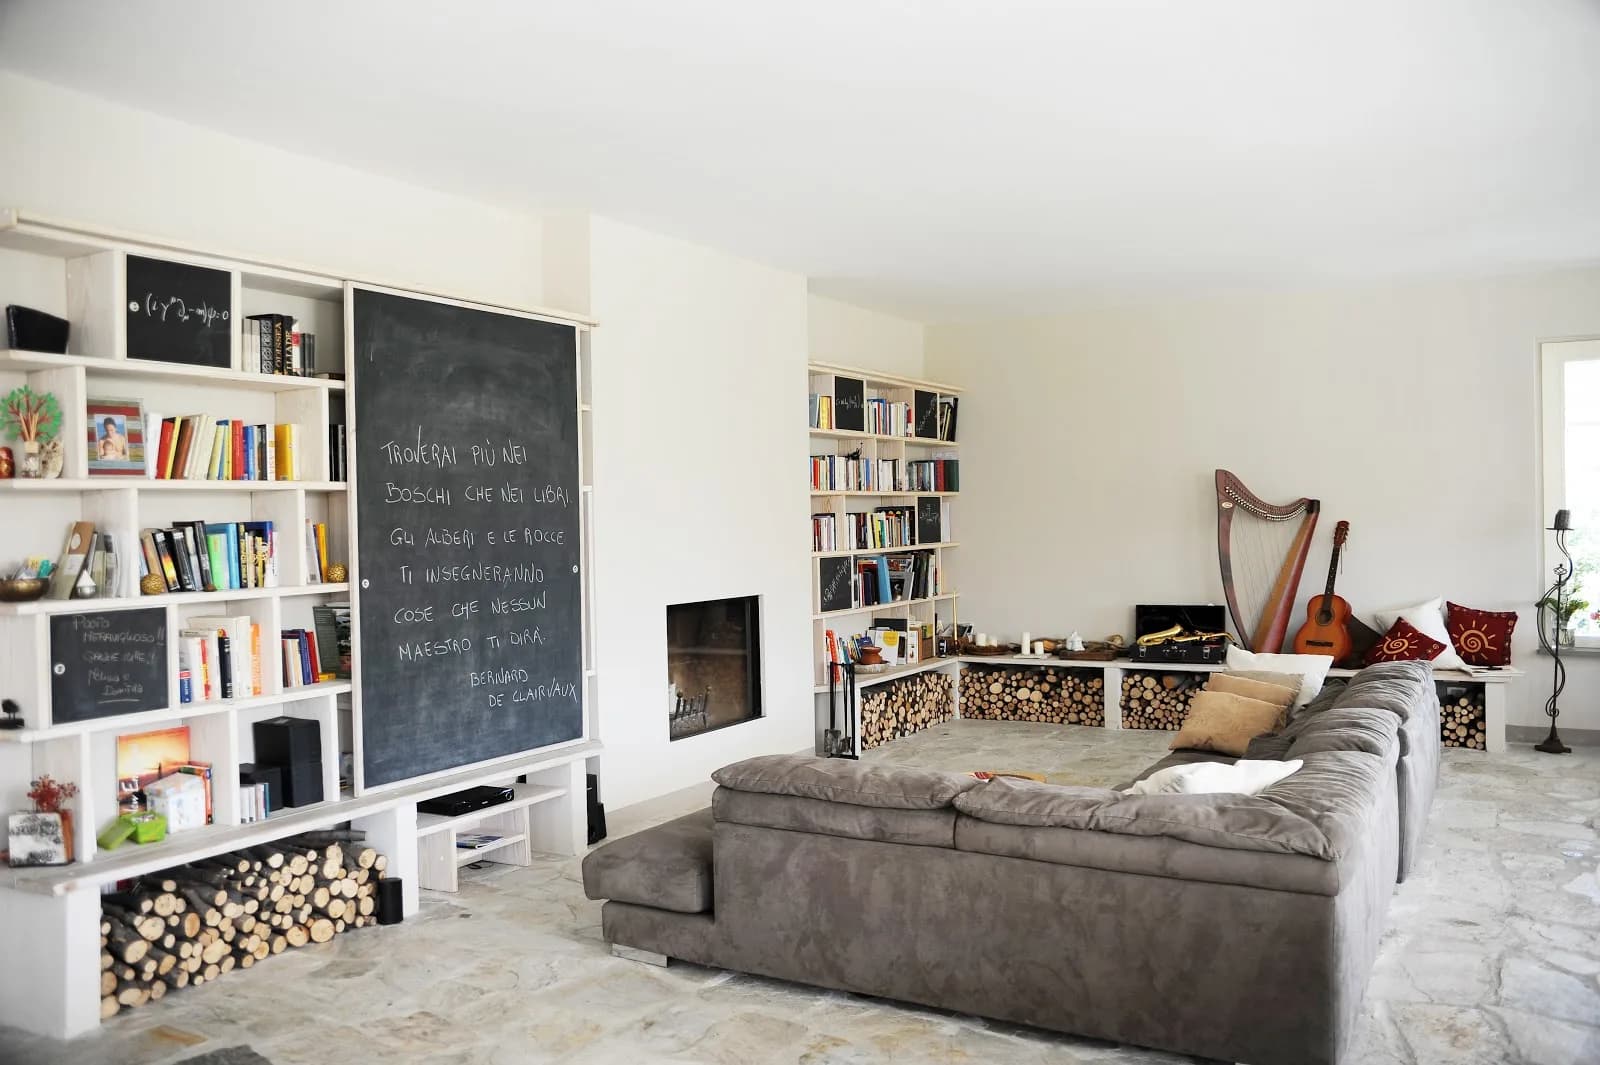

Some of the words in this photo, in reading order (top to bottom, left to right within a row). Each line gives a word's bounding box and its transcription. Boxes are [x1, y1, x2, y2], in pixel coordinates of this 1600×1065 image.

[381, 425, 457, 468] TROVERAI
[503, 439, 527, 464] NEI
[385, 482, 451, 505] BOSCHI
[465, 485, 493, 503] CHE
[501, 481, 523, 503] NEI
[390, 527, 414, 545] GLI
[425, 527, 474, 549] ALBERI
[487, 530, 496, 545] E
[503, 529, 516, 543] LE
[524, 528, 565, 546] ROCCE
[400, 565, 412, 585] TI
[426, 562, 544, 586] INSEGNERANNO
[394, 606, 433, 624] COSE
[451, 600, 479, 620] CHE
[491, 590, 547, 615] NESSUN
[398, 637, 471, 662] MAESTRO
[486, 635, 500, 649] TI
[470, 667, 529, 688] BERNARD
[488, 693, 504, 707] DE
[512, 677, 578, 704] CLAIRVAUX
